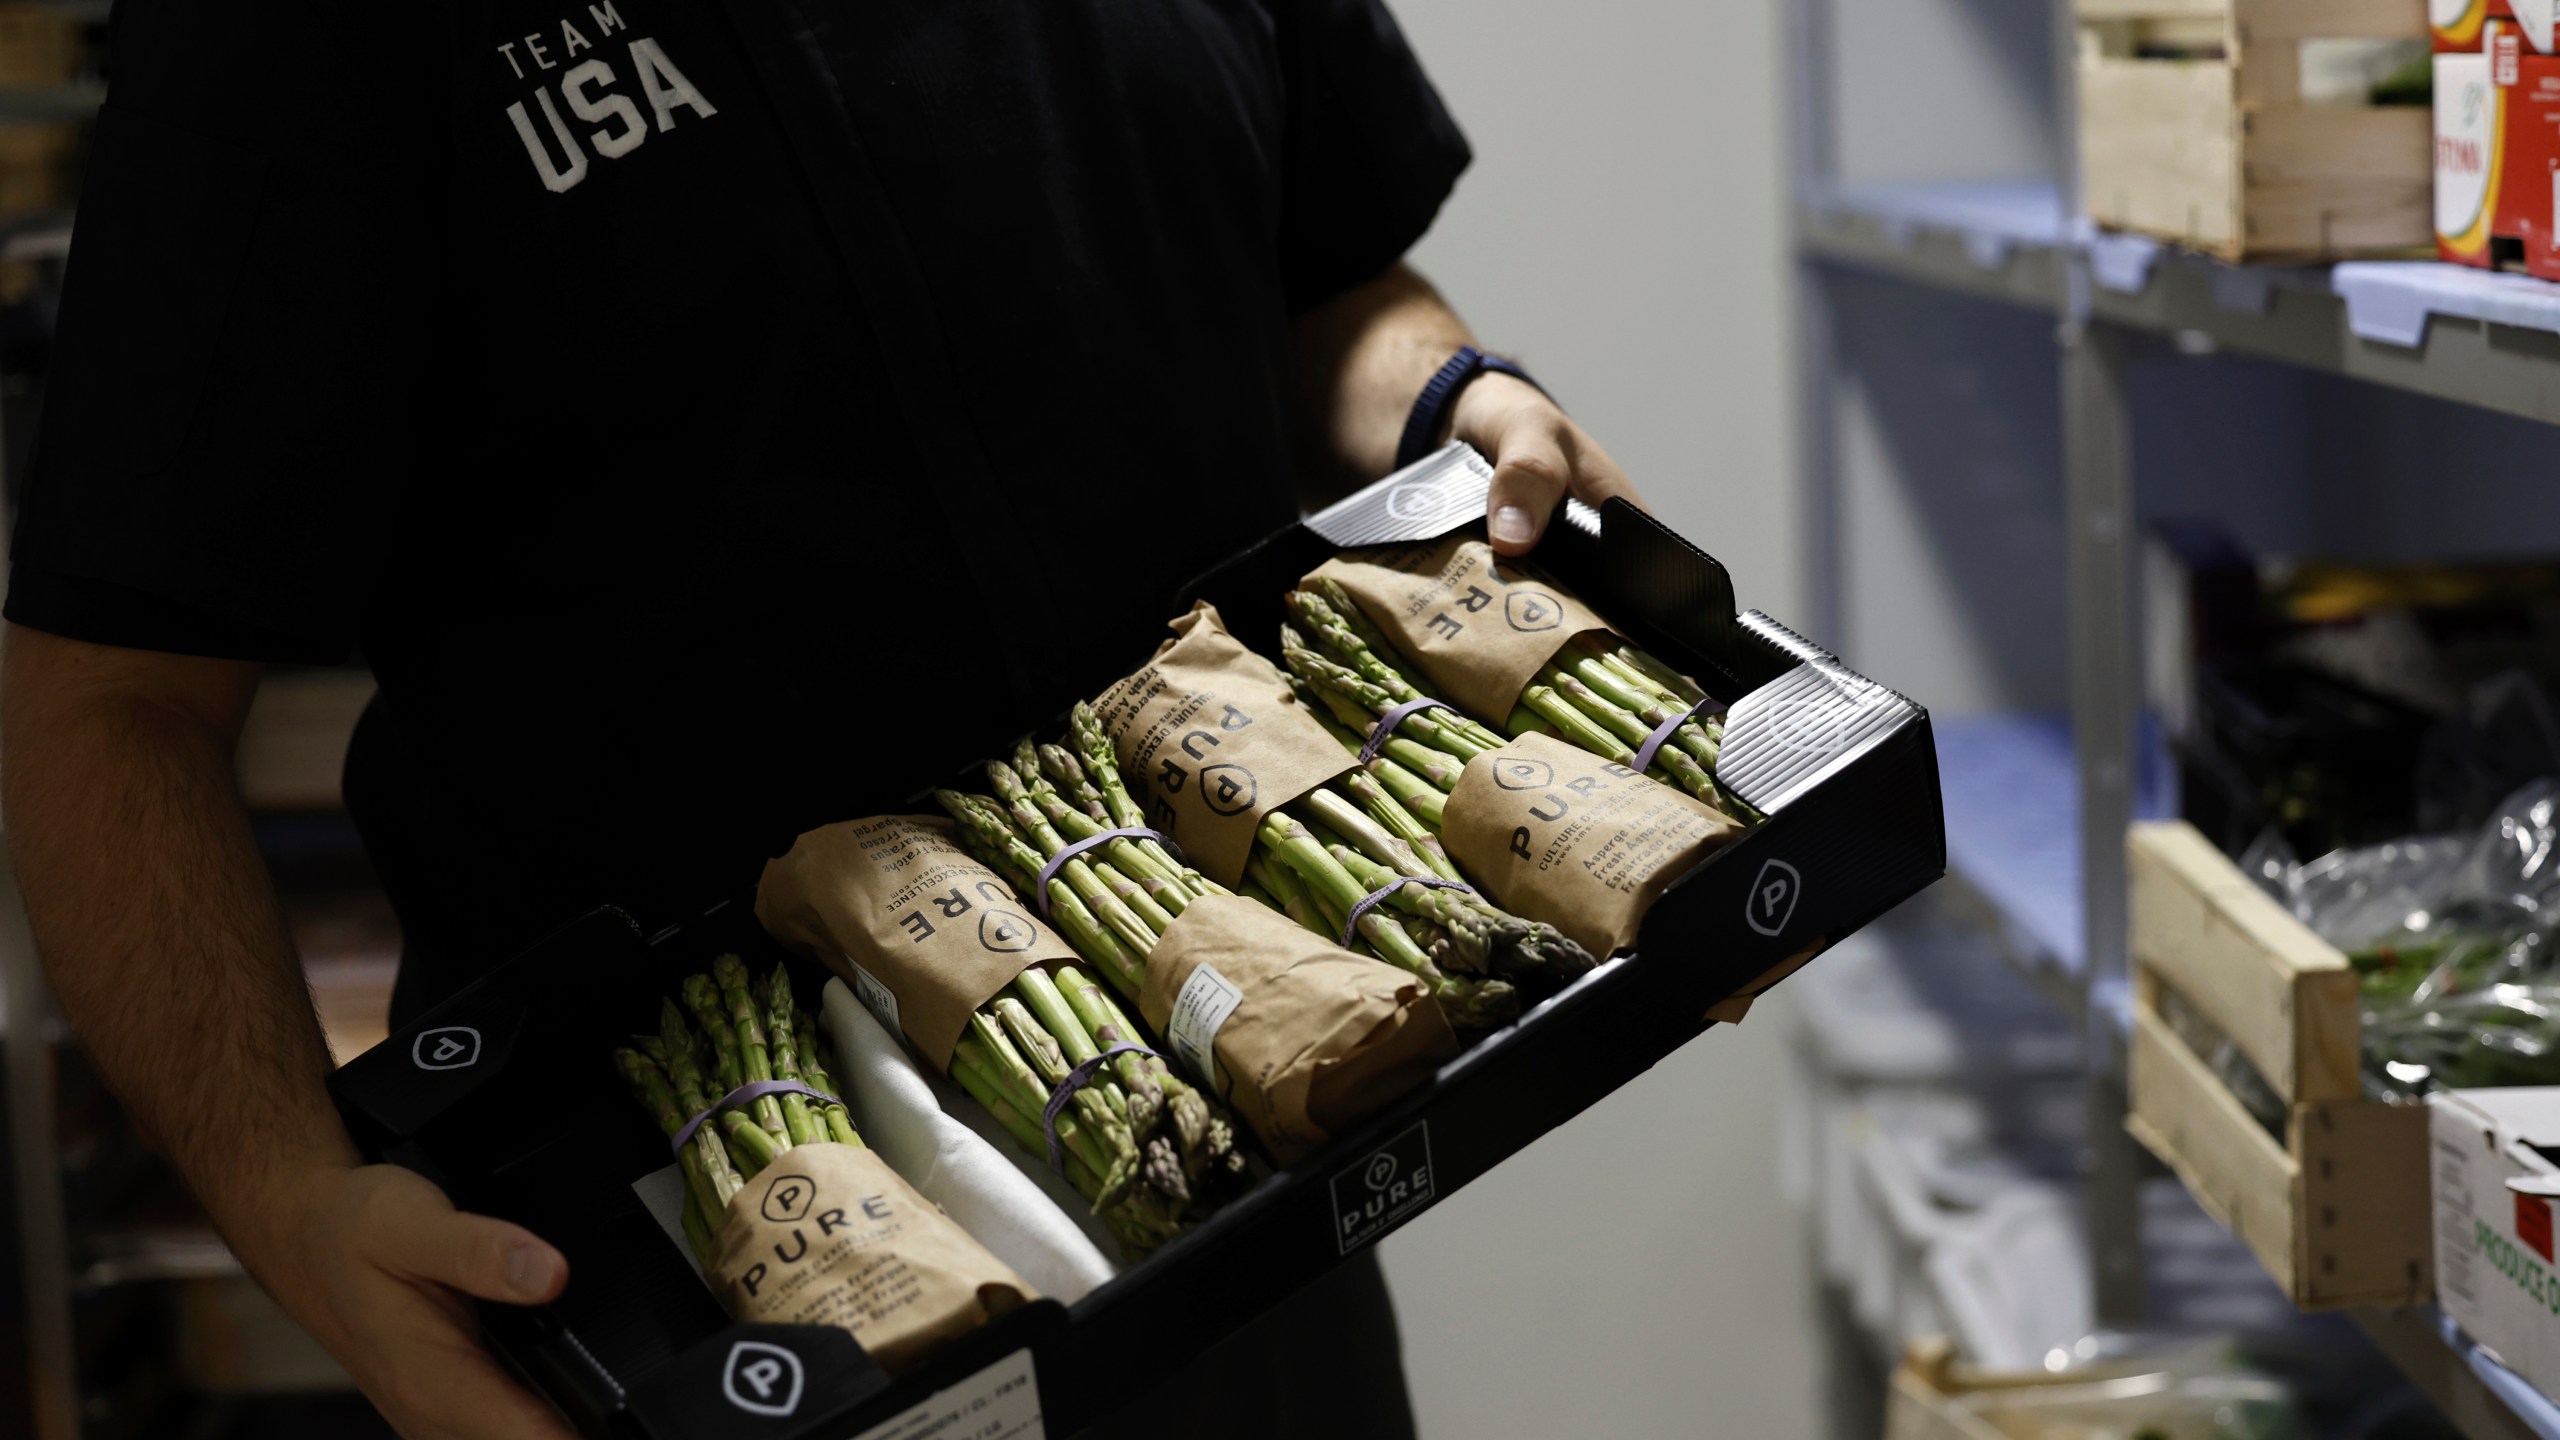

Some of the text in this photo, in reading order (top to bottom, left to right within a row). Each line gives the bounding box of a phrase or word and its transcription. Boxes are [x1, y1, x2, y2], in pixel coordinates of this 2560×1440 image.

[497, 0, 627, 79] TEAM
[506, 37, 718, 193] USA
[1523, 599, 1549, 623] P
[1126, 679, 1168, 720] Asperge
[1128, 667, 1159, 696] Fresh
[1154, 703, 1253, 831] PURE
[1507, 764, 1535, 780] P
[1217, 774, 1244, 804] P
[1509, 762, 1642, 861] PURE
[860, 831, 900, 849] Fresco
[870, 836, 935, 861] Asparagus
[1538, 822, 1582, 872] CULTURE
[1582, 830, 1628, 870] Asperge
[882, 848, 928, 873] Fraîche
[1593, 851, 1627, 880] Fresh
[1605, 840, 1665, 890] Espárrago
[886, 868, 968, 913] D'EXCELLENCE
[1763, 879, 1787, 918] P
[996, 919, 1022, 941] P
[433, 1036, 465, 1061] P
[1374, 1162, 1390, 1181] P
[776, 1185, 800, 1212] P
[1342, 1166, 1428, 1234] PURE
[741, 1194, 894, 1298] PURE
[2475, 1218, 2545, 1305] PRODUCE
[742, 1359, 783, 1399] P
